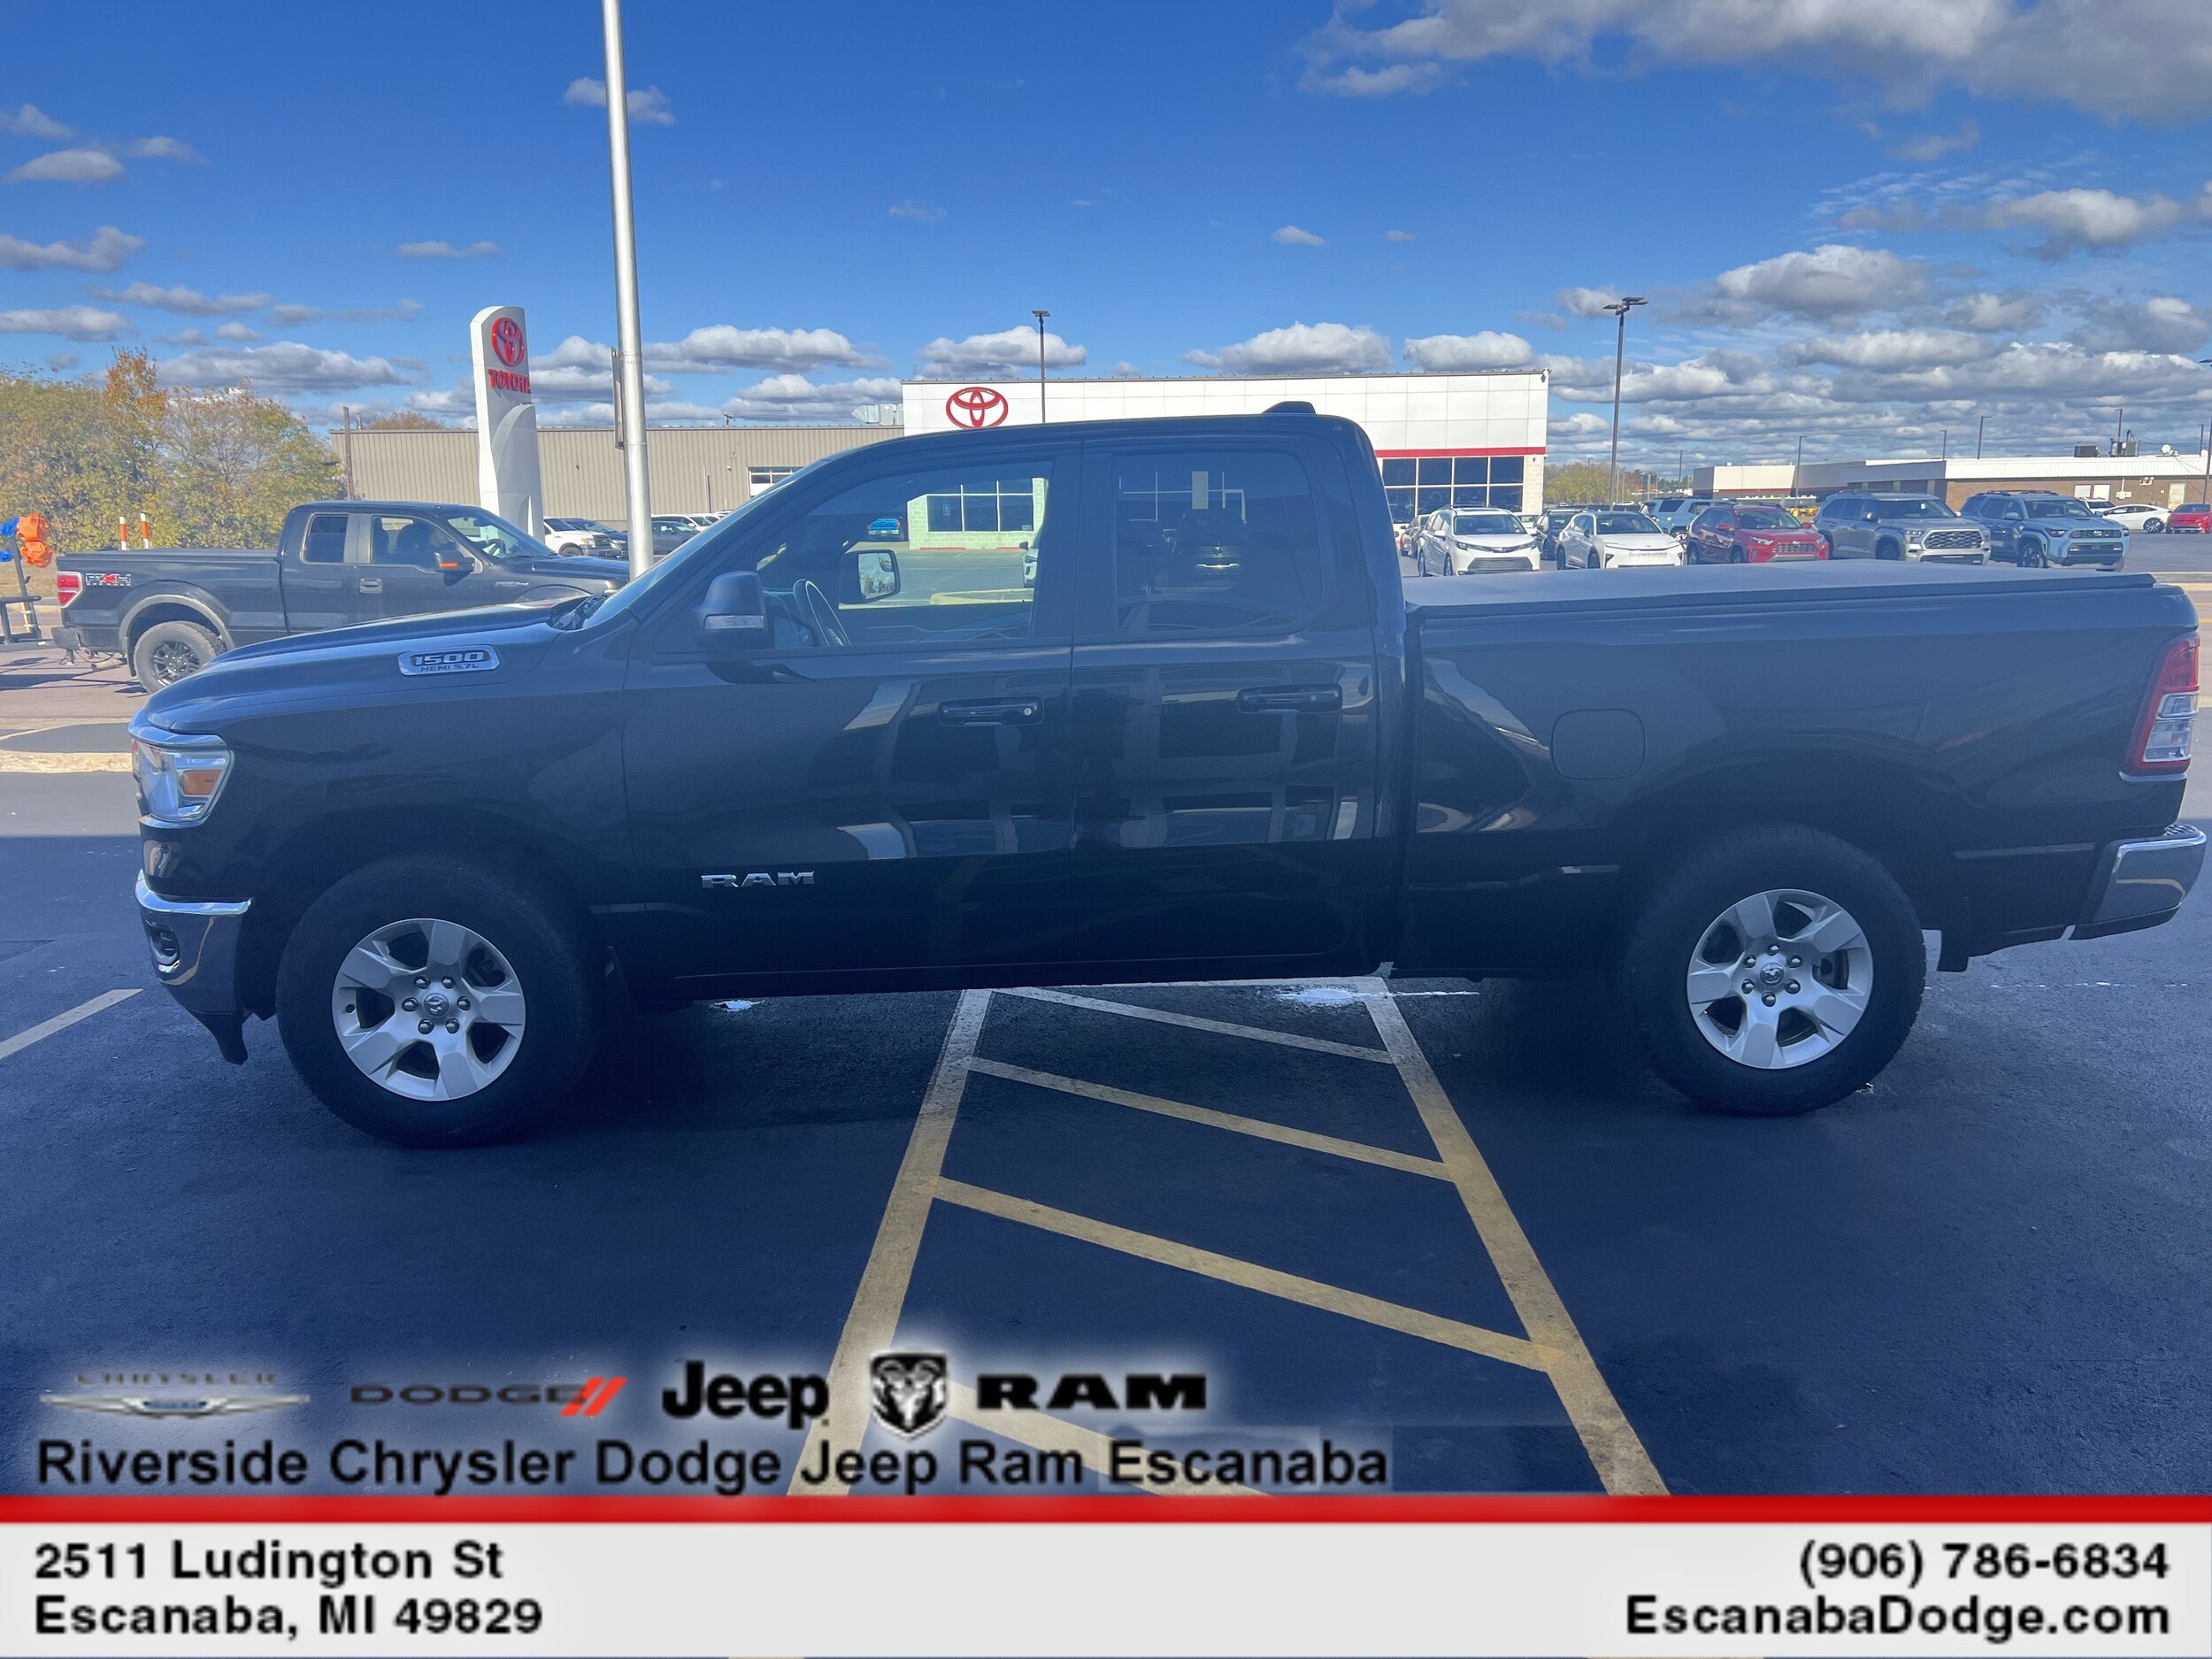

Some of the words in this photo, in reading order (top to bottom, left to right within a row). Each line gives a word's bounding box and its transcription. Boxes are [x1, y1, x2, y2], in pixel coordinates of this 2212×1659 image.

[488, 368, 531, 394] TOYOTA
[86, 572, 131, 584] FX4
[415, 651, 484, 665] 1500
[701, 872, 815, 888] RAM
